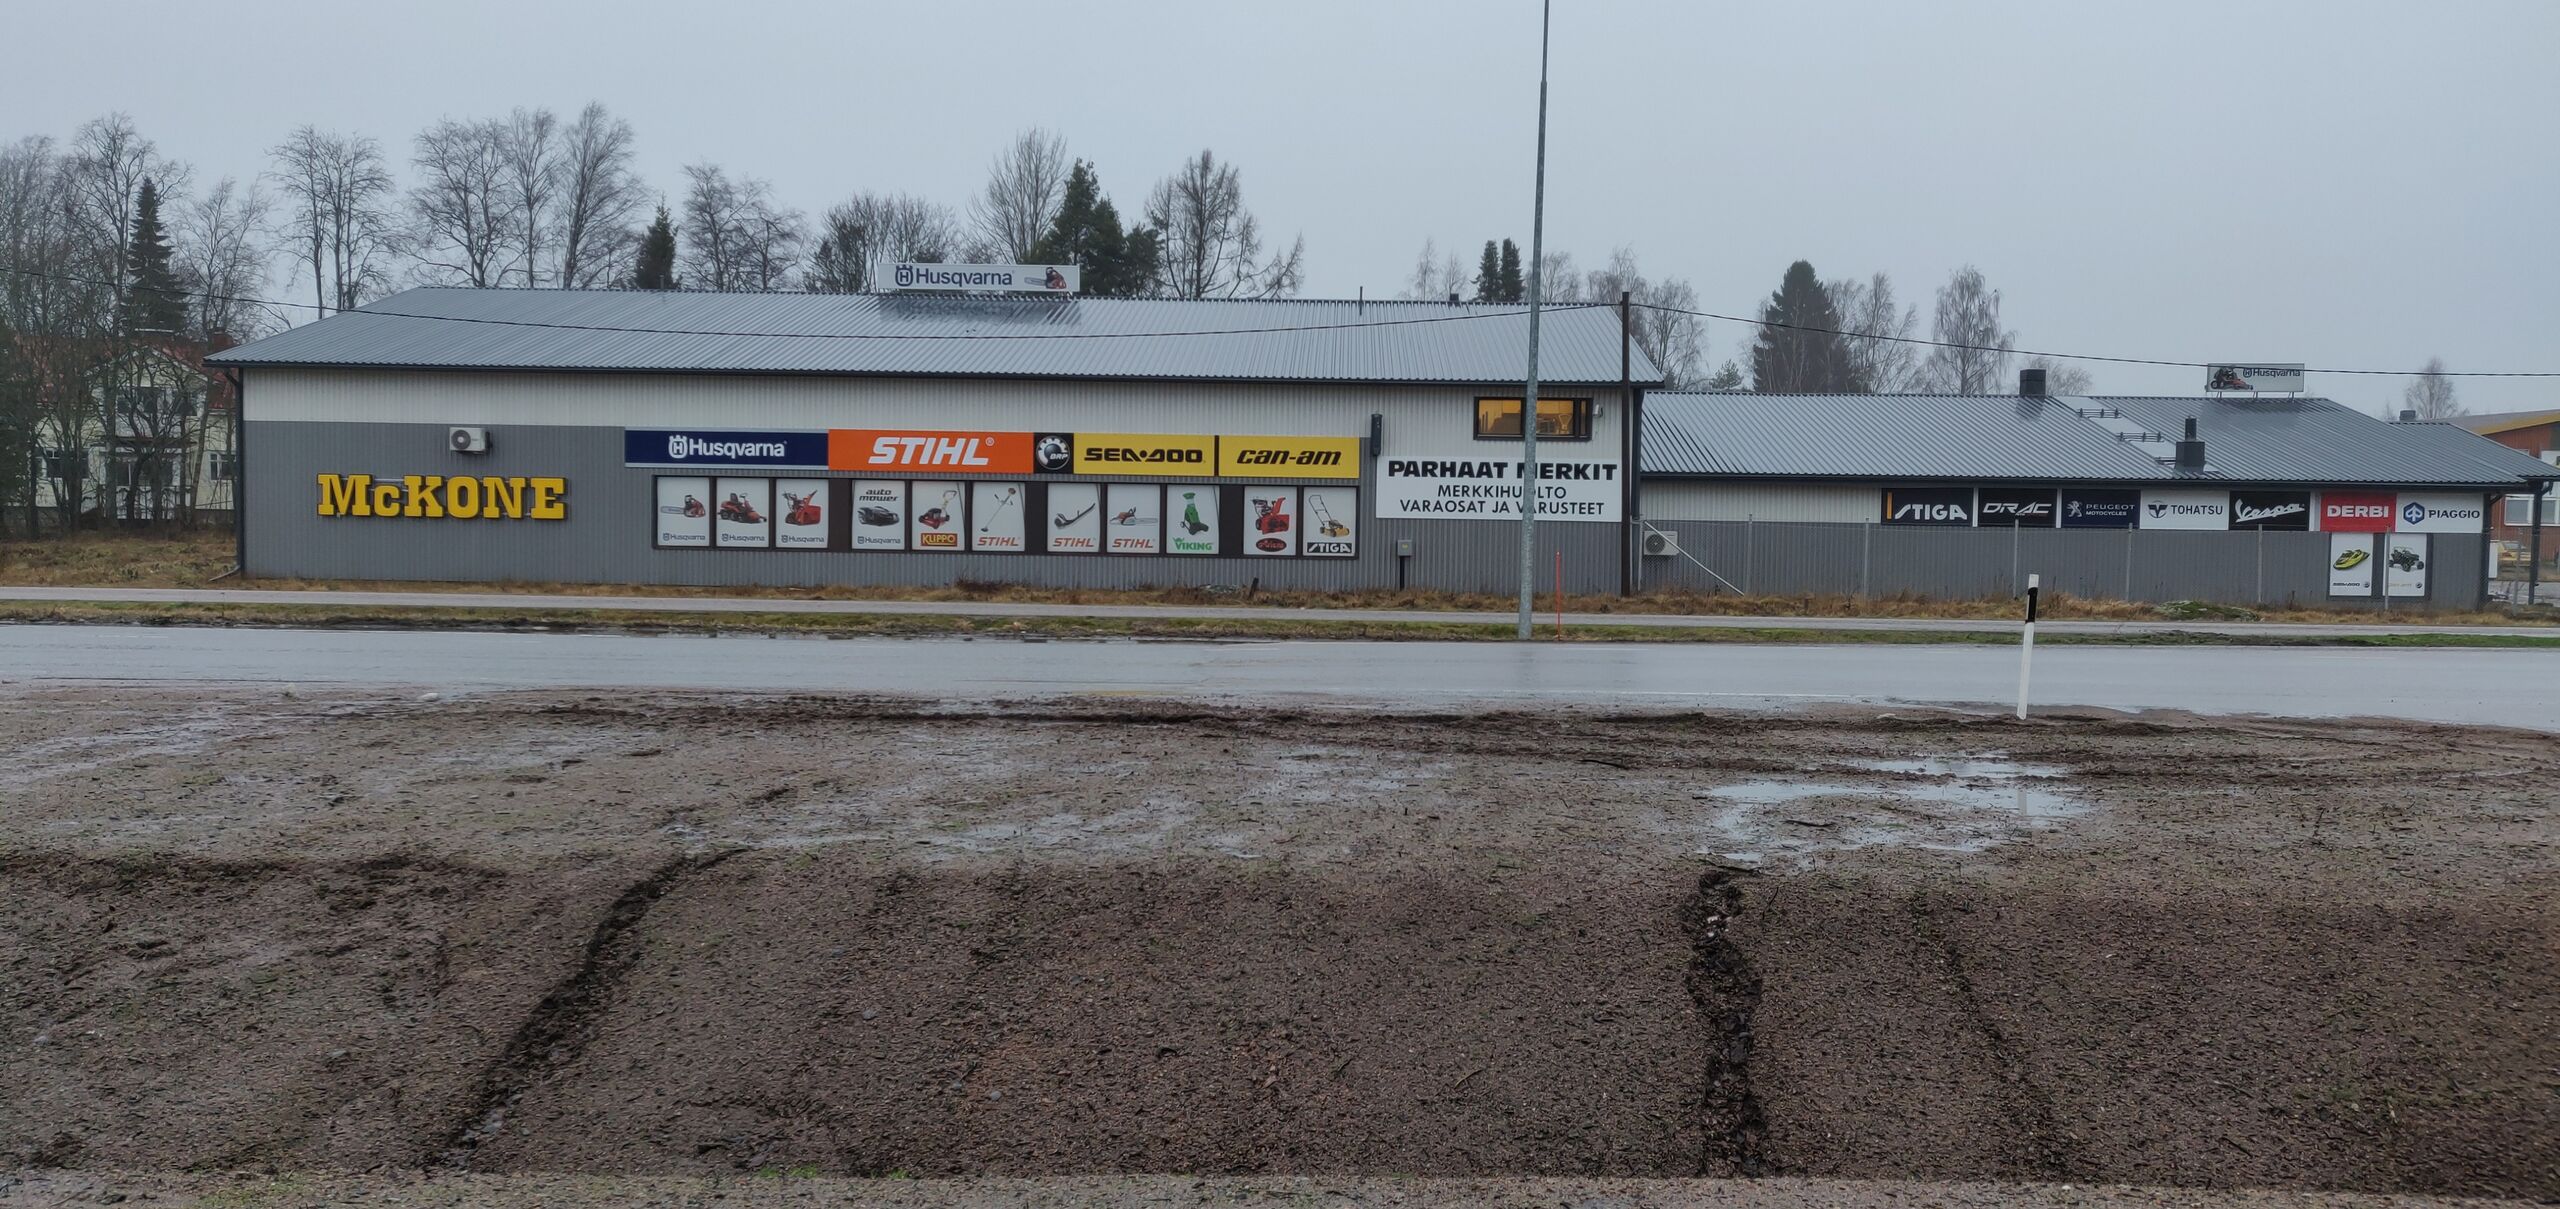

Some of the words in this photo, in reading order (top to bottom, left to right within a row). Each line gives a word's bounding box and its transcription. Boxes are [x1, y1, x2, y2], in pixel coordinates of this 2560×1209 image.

[916, 268, 1013, 287] Husqvarna
[2253, 367, 2301, 378] Husqvarna
[689, 438, 785, 459] Husqvarna
[868, 437, 989, 466] STIHL
[1237, 449, 1342, 466] can-am
[1388, 460, 1509, 479] PARHAAT
[317, 474, 565, 520] McKONE
[865, 488, 892, 496] auto
[1437, 484, 1567, 499] MERKKIHULTO
[1400, 499, 1487, 514] VARAOSAT
[1492, 501, 1511, 514] JA
[1515, 501, 1605, 515] VRUSTEET
[1895, 504, 1968, 521] STIGA
[2171, 504, 2224, 515] TOHATSU
[2234, 498, 2305, 523] Vespa
[2327, 504, 2389, 518] DERBI
[2428, 508, 2481, 519] PIAGGIO
[670, 533, 706, 542] Husqvarna
[729, 534, 766, 543] Husqvarna
[788, 535, 825, 544] Husqvarna
[864, 536, 901, 545] Husqvarna
[977, 536, 1019, 547] STIHL
[1053, 537, 1094, 548] STIHL
[1112, 538, 1153, 549] STIHL
[1175, 541, 1213, 551] VIKING
[1308, 543, 1352, 553] STIGA
